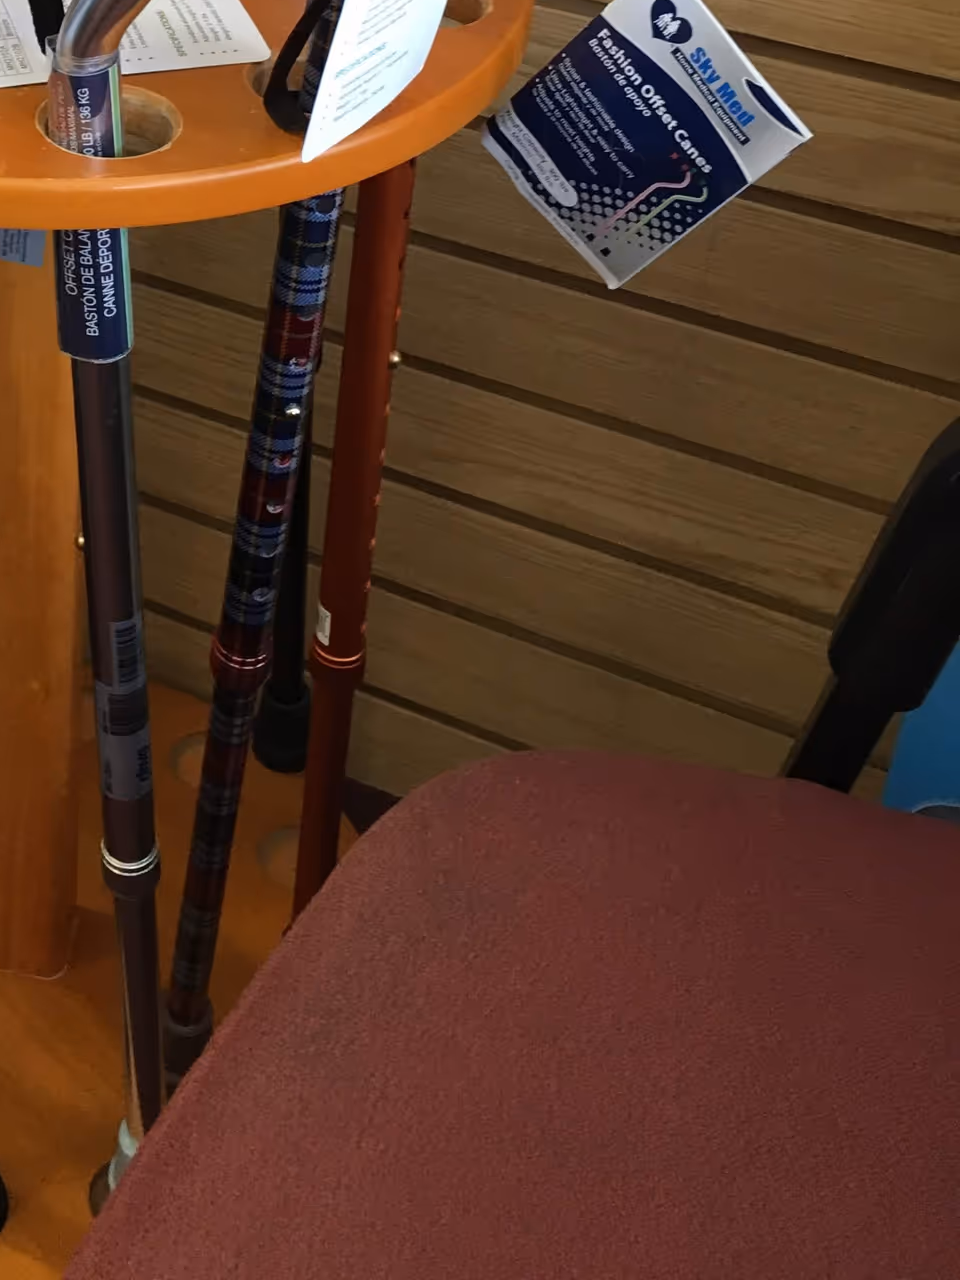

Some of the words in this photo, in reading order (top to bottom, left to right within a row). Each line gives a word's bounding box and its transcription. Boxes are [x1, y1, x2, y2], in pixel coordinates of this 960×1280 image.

[77, 88, 90, 103] KG
[587, 37, 620, 74] Bastón
[613, 70, 628, 87] de
[622, 84, 653, 119] apoyo
[596, 27, 645, 87] Fashion
[638, 82, 679, 132] Offset
[672, 127, 714, 175] Canes
[674, 51, 694, 75] Home
[691, 73, 716, 104] Medical
[711, 101, 746, 142] Equipment
[687, 45, 722, 88] Sky
[715, 81, 756, 128] Med
[68, 105, 76, 140] MAXIMAL
[80, 106, 91, 123] 136
[535, 81, 557, 111] Adjusts
[553, 108, 563, 118] to
[559, 117, 576, 136] most
[572, 134, 596, 163] heights
[561, 57, 583, 83] Stylish
[582, 87, 617, 129] fashionable
[613, 127, 636, 154] design
[81, 132, 93, 145] LB
[595, 134, 612, 154] easy
[609, 151, 619, 162] to
[616, 160, 636, 180] carry
[62, 244, 77, 294] OFFSET
[81, 267, 94, 284] DE
[80, 287, 99, 335] BASTÓN
[102, 274, 117, 316] CANNE
